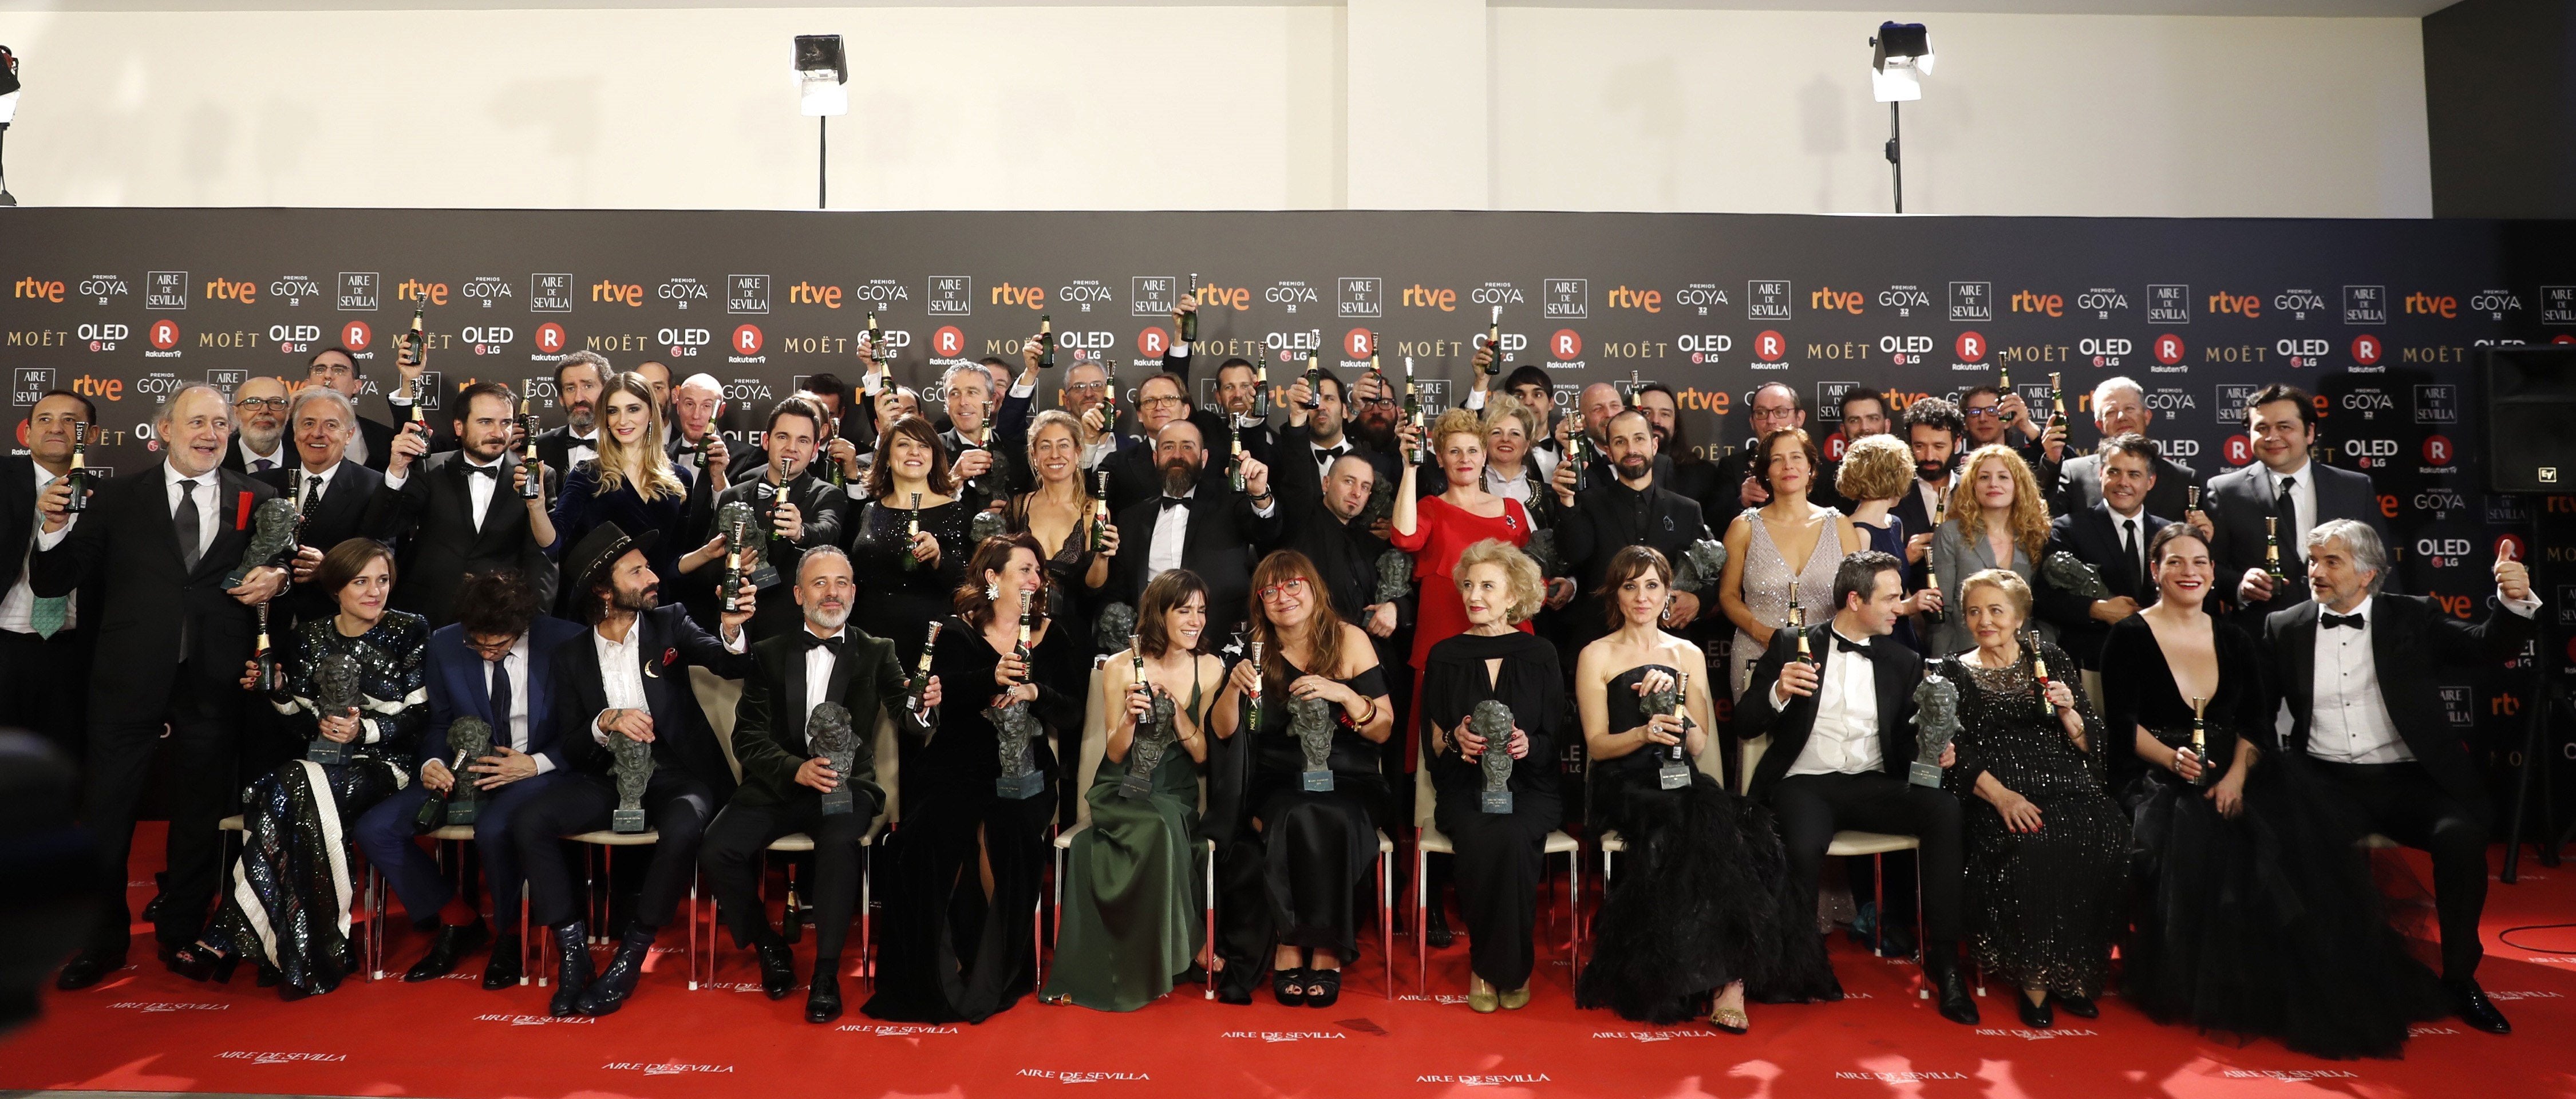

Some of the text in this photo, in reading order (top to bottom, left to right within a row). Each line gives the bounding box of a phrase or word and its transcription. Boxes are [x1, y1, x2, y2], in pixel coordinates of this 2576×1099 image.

[157, 275, 178, 284] AIRE
[348, 276, 369, 286] AIRE
[542, 277, 563, 287] AIRE
[738, 278, 760, 288] AIRE
[939, 279, 961, 290] AIRE
[1143, 280, 1165, 290] AIRE
[1349, 281, 1372, 291] AIRE
[1555, 282, 1577, 292] AIRE
[15, 277, 65, 302] rtve
[80, 281, 128, 295] GOYA
[207, 278, 256, 303] rtve
[271, 282, 319, 295] GOYA
[399, 279, 448, 305] rtve
[463, 283, 511, 297] GOYA
[593, 280, 643, 306] rtve
[658, 284, 708, 298] GOYA
[791, 282, 841, 309] rtve
[858, 286, 907, 300] GOYA
[1060, 287, 1111, 301] GOYA
[1266, 287, 1317, 302] GOYA
[1472, 288, 1523, 303] GOYA
[1759, 284, 1781, 294] AIRE
[1959, 285, 1981, 295] AIRE
[2158, 288, 2179, 298] AIRE
[2354, 289, 2375, 299] AIRE
[2551, 290, 2573, 299] AIRE
[149, 295, 184, 305] SEVILLA
[341, 296, 375, 306] SEVILLA
[534, 298, 568, 308] SEVILLA
[993, 283, 1044, 309] rtve
[1196, 283, 1250, 310] rtve
[1404, 284, 1456, 311] rtve
[1609, 286, 1661, 313] rtve
[1677, 290, 1728, 305] GOYA
[1812, 287, 1863, 314] rtve
[1879, 291, 1929, 306] GOYA
[2012, 290, 2063, 317] rtve
[2078, 294, 2128, 309] GOYA
[2274, 295, 2325, 310] GOYA
[2471, 295, 2521, 310] GOYA
[730, 299, 766, 309] SEVILLA
[931, 301, 967, 311] SEVILLA
[1135, 301, 1172, 311] SEVILLA
[1287, 305, 1296, 313] 32
[1341, 302, 1378, 313] SEVILLA
[1547, 303, 1584, 314] SEVILLA
[1752, 305, 1788, 315] SEVILLA
[1953, 306, 1988, 317] SEVILLA
[2210, 291, 2259, 318] rtve
[2406, 292, 2456, 318] rtve
[2151, 309, 2187, 319] SEVILLA
[2347, 310, 2383, 320] SEVILLA
[7, 330, 67, 346] MOËT
[78, 324, 128, 339] OLED
[200, 331, 259, 347] MOËT
[270, 325, 319, 341] OLED
[463, 327, 513, 343] OLED
[658, 329, 710, 345] OLED
[102, 342, 114, 350] LG
[587, 334, 647, 350] MOËT
[785, 336, 846, 353] MOËT
[1061, 331, 1114, 348] OLED
[1192, 339, 1255, 355] MOËT
[1678, 335, 1731, 351] OLED
[1880, 336, 1933, 353] OLED
[2080, 339, 2131, 355] OLED
[2277, 339, 2329, 355] OLED
[488, 346, 500, 354] LG
[684, 347, 697, 356] LG
[1088, 351, 1100, 359] LG
[1398, 339, 1461, 357] MOËT
[1605, 341, 1667, 358] MOËT
[1808, 342, 1869, 359] MOËT
[2008, 345, 2069, 361] MOËT
[2206, 346, 2266, 362] MOËT
[2404, 346, 2463, 362] MOËT
[1294, 352, 1307, 360] LG
[1705, 354, 1718, 362] LG
[1907, 355, 1920, 363] LG
[2106, 358, 2119, 366] LG
[2304, 358, 2317, 366] LG
[73, 375, 123, 401] rtve
[722, 384, 771, 400] GOYA
[1677, 387, 1729, 414] rtve
[2146, 394, 2195, 409] GOYA
[2342, 394, 2393, 409] GOYA
[2345, 440, 2397, 456] OLED
[2372, 458, 2385, 467] LG
[2414, 494, 2465, 509] GOYA
[2417, 539, 2470, 555] OLED
[284, 1053, 346, 1061] SEVILLA
[670, 1064, 733, 1073] SEVILLA
[1016, 1069, 1055, 1078] AIRE
[1085, 1072, 1150, 1080] SEVILLA
[1485, 1073, 1551, 1082] SEVILLA
